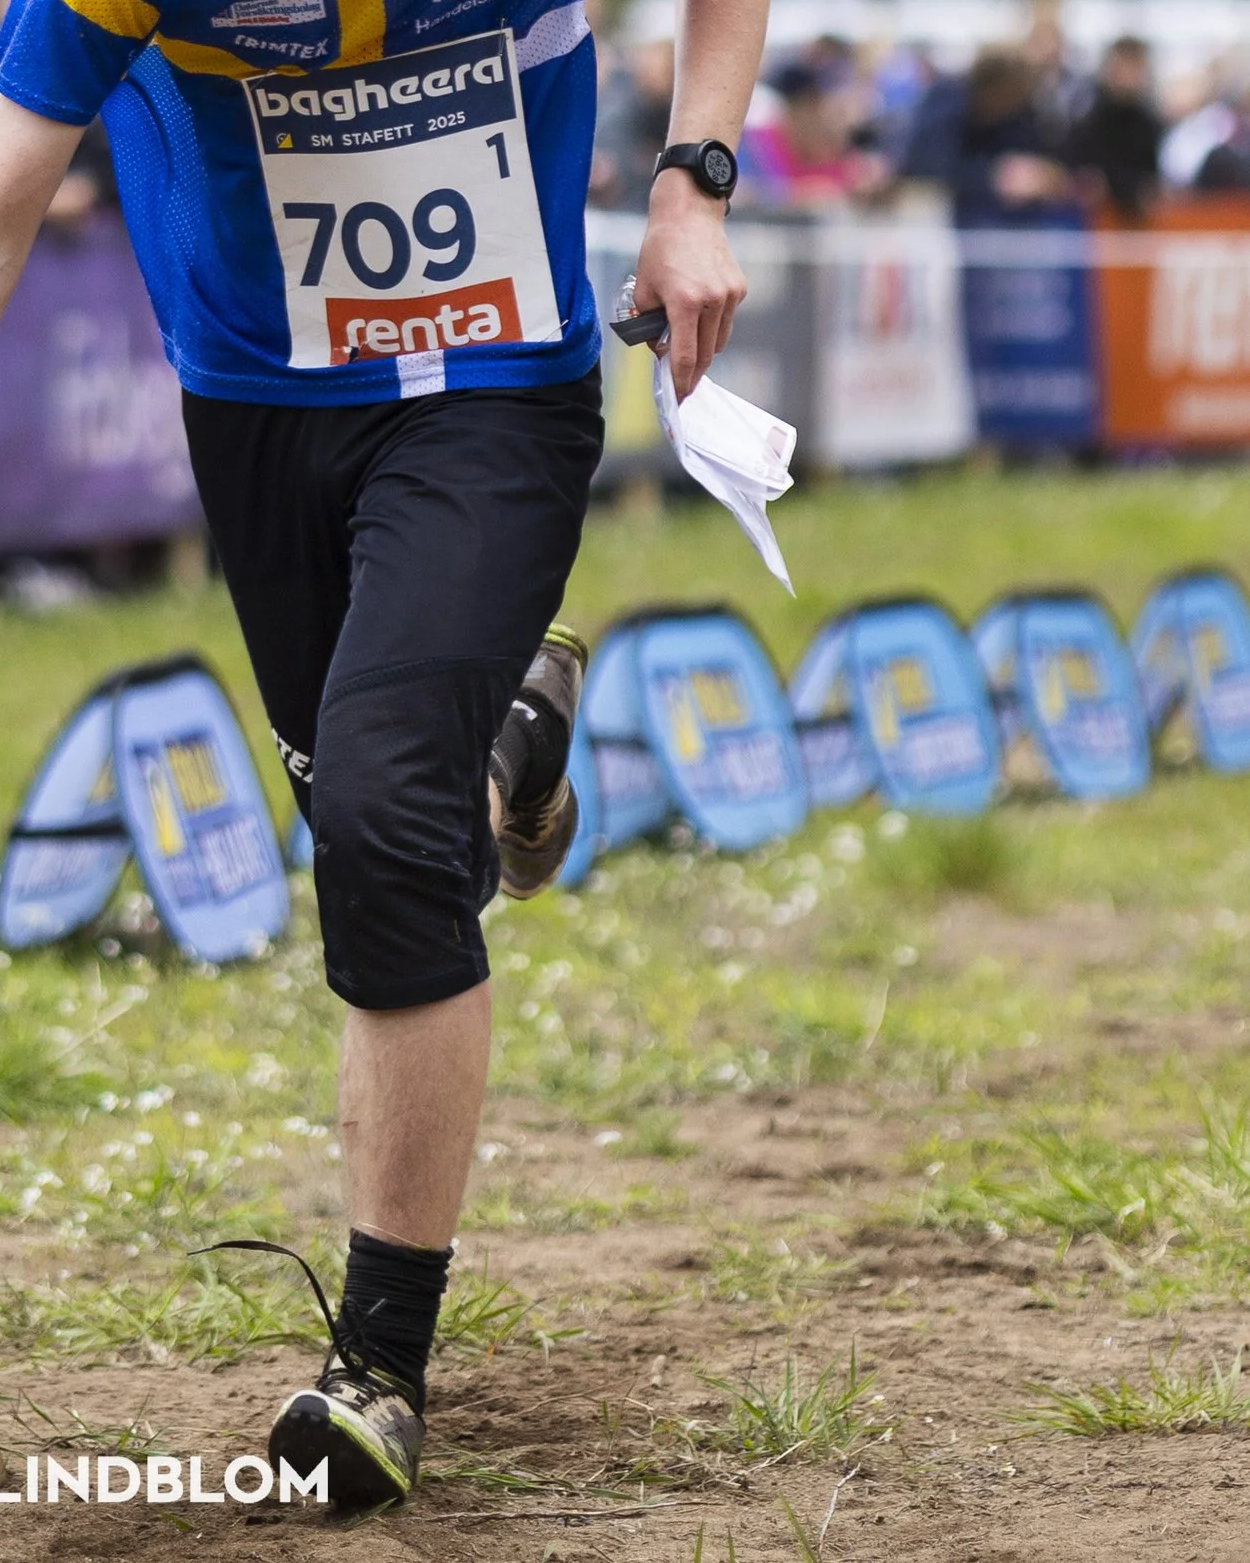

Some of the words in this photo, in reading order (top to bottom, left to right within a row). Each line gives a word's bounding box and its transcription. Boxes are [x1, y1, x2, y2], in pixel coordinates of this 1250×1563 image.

[257, 55, 504, 121] bagheera
[311, 134, 333, 147] SM
[342, 124, 414, 146] STAFETT
[428, 111, 466, 132] 2025
[486, 132, 510, 179] 1
[282, 188, 477, 290] 709
[344, 303, 502, 354] renta
